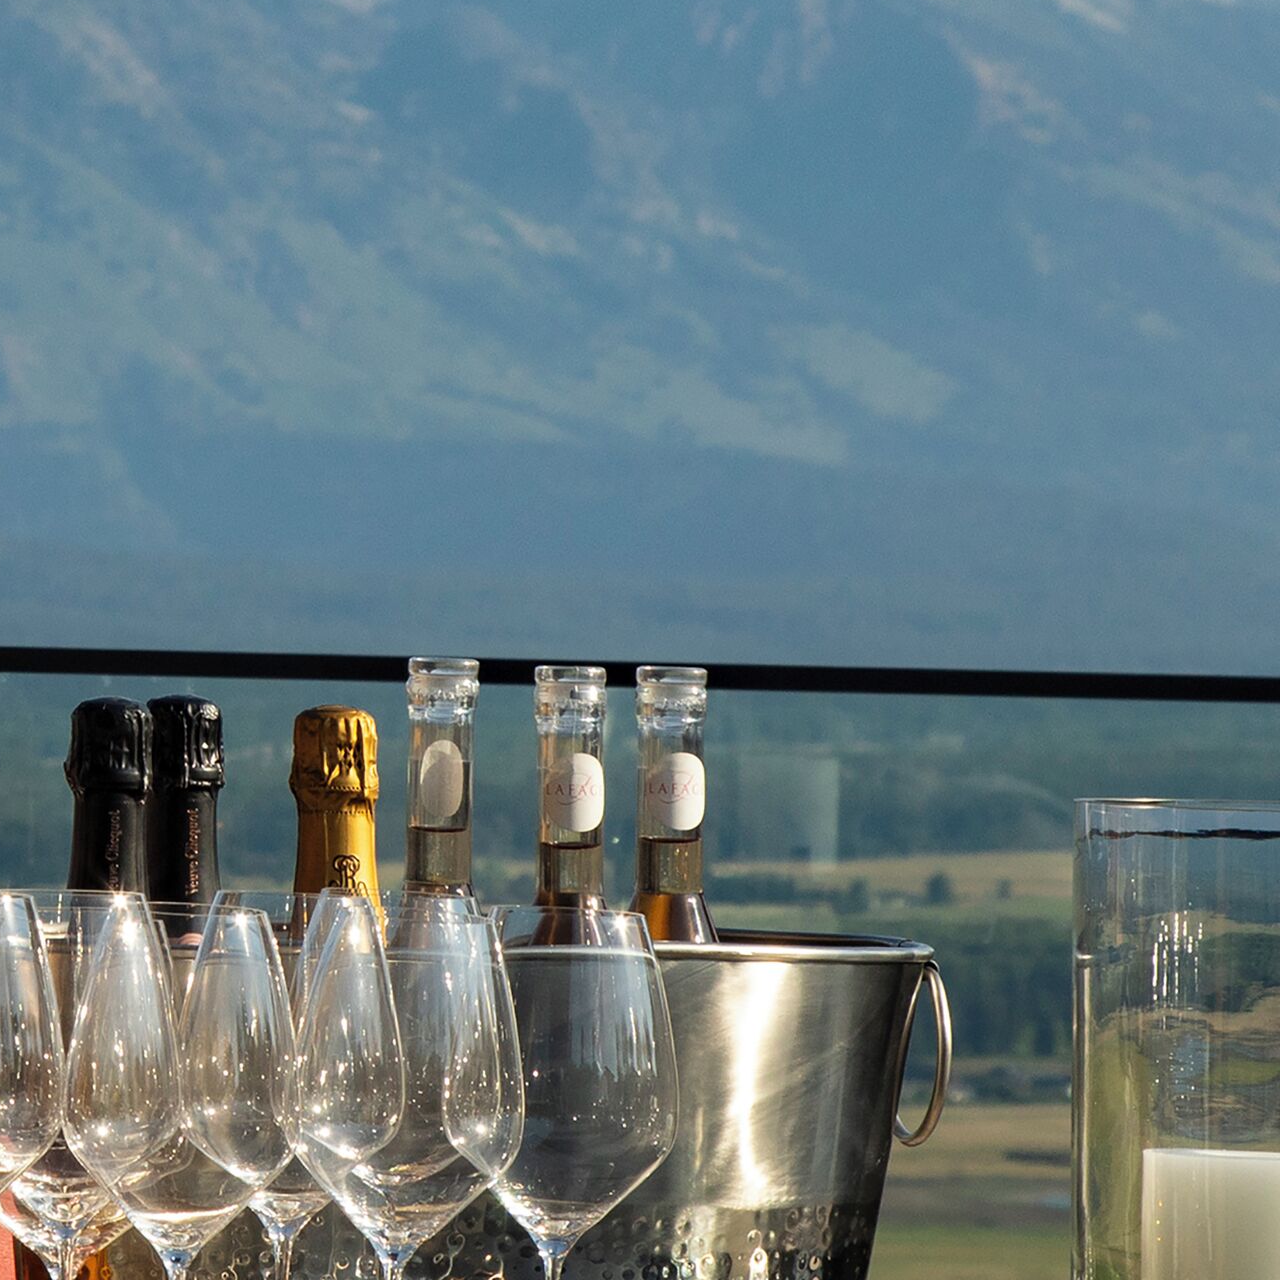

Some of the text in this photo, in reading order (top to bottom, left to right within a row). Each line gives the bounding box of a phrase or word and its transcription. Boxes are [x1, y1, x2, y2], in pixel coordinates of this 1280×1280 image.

[106, 809, 122, 891] euve Clicquot
[184, 807, 201, 896] Veuve Clicquot
